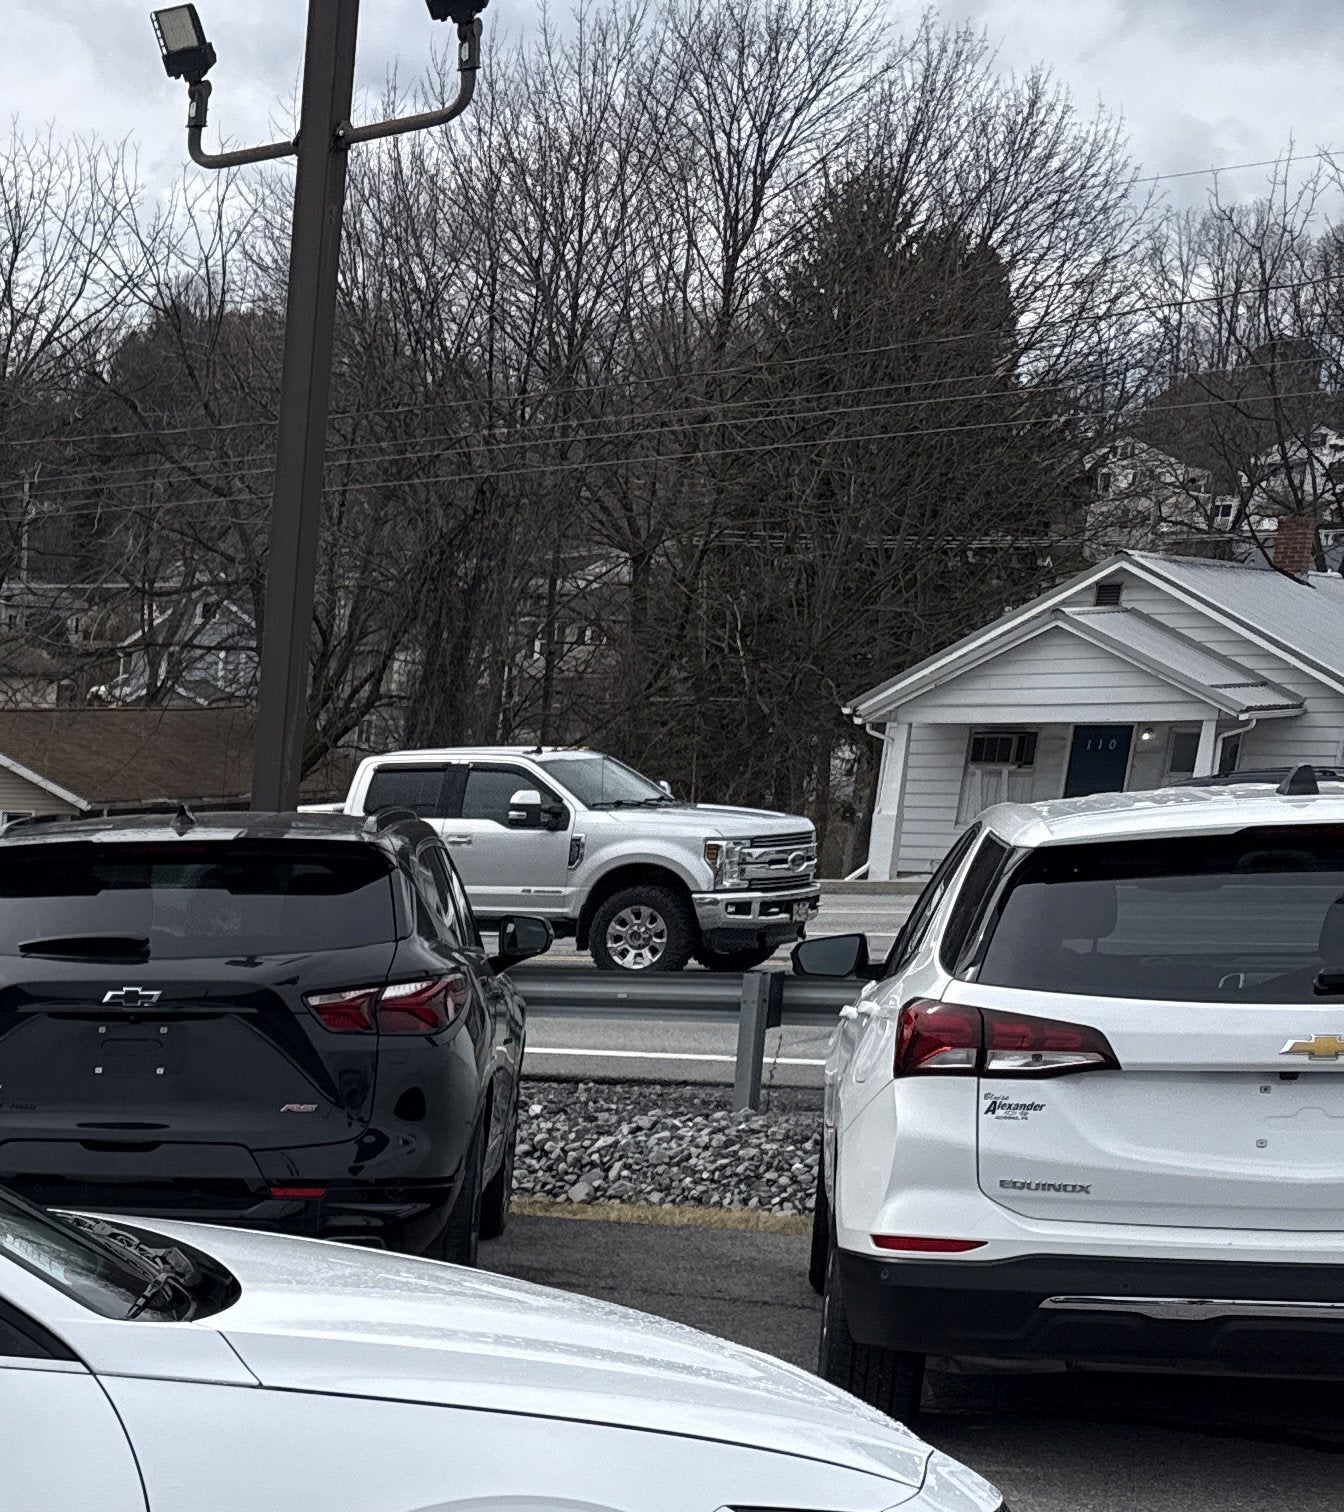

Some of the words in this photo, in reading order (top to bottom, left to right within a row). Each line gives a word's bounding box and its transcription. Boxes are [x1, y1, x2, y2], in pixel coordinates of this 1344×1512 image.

[1086, 738, 1117, 750] 110
[984, 1101, 1046, 1115] Alexander
[998, 1179, 1092, 1195] EQUINOX
